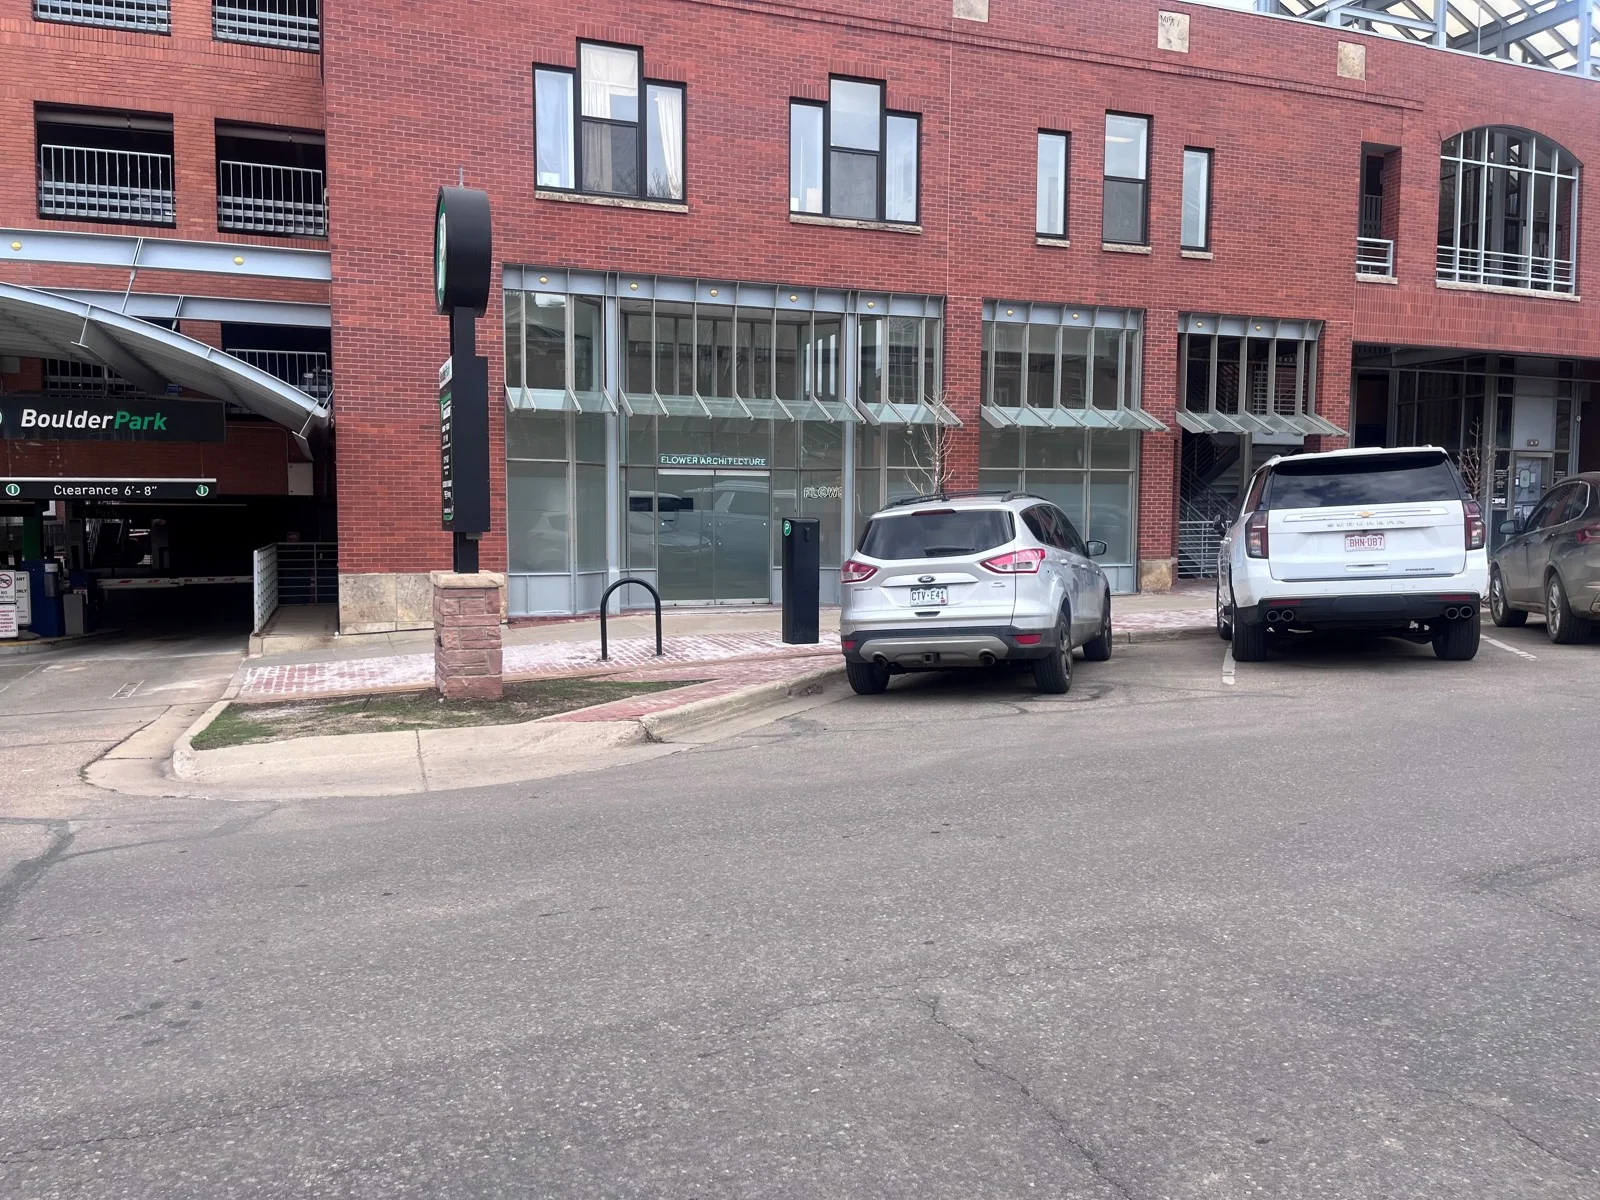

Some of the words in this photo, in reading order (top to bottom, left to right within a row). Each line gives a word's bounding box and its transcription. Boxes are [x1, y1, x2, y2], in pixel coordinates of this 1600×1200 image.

[20, 408, 168, 431] BoulderPark
[661, 456, 698, 465] FLOWER
[699, 456, 766, 466] ARCHITECTURE
[53, 484, 119, 496] Clearance
